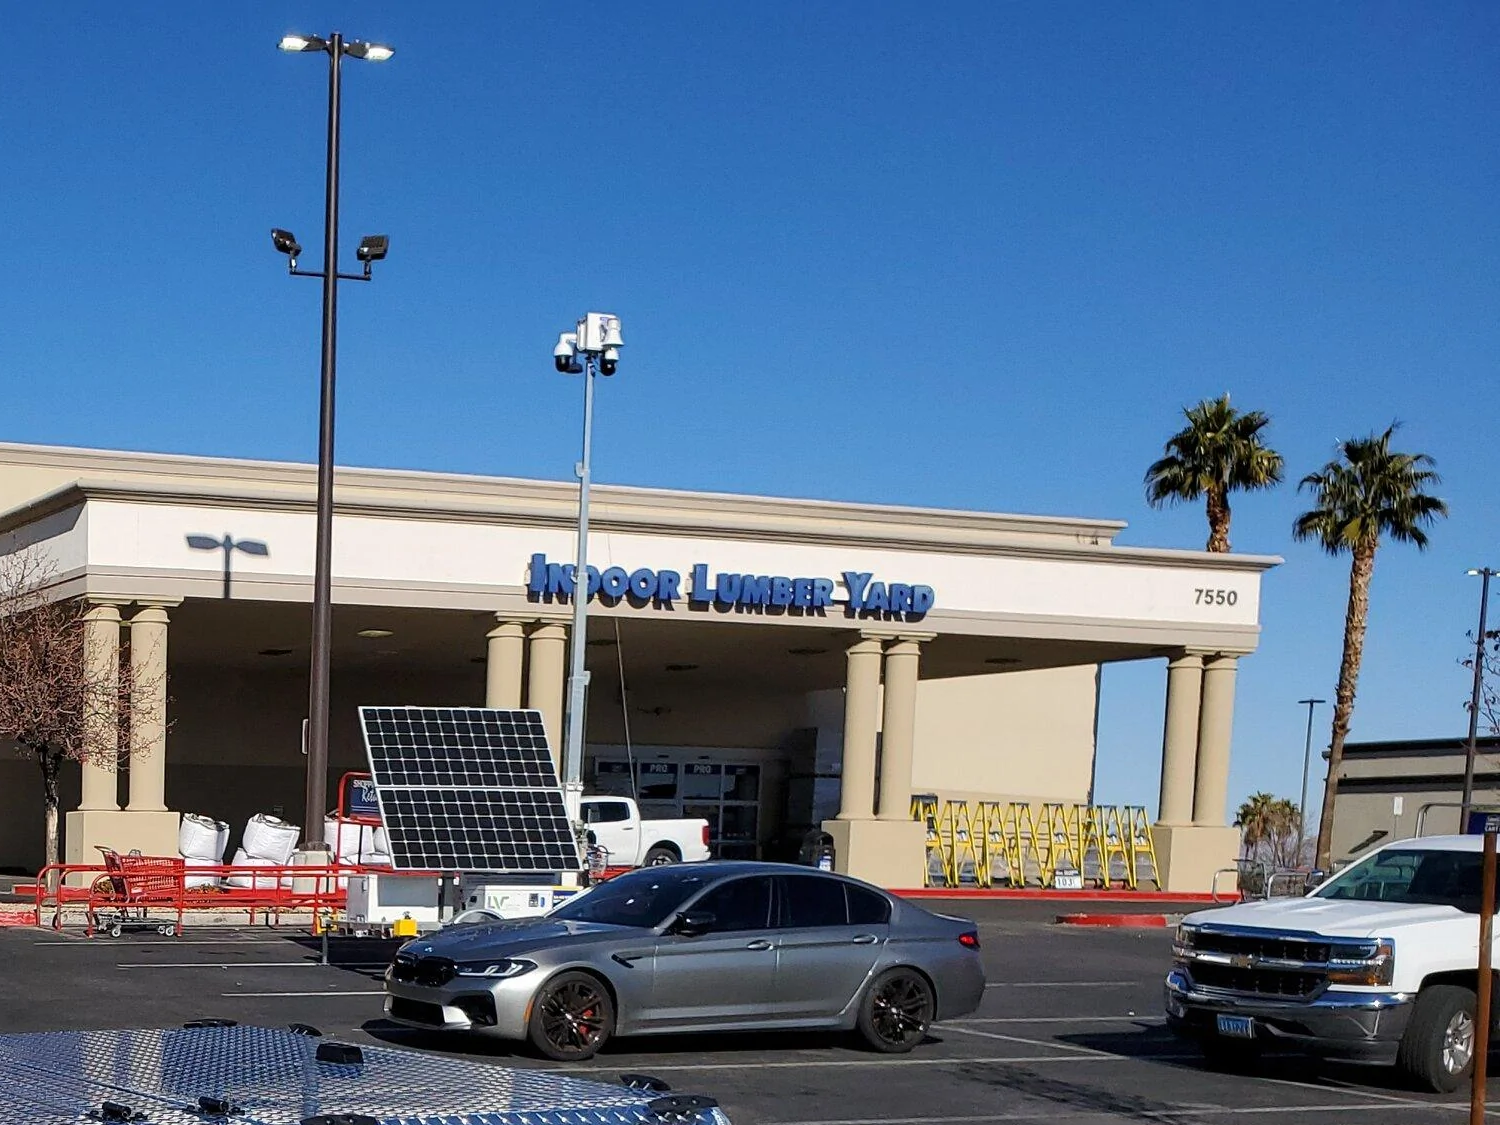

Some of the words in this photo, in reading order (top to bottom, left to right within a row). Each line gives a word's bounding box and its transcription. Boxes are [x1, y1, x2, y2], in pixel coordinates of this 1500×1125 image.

[529, 553, 682, 600] INDOOR
[691, 563, 835, 607] LUMBER
[841, 572, 935, 613] YARD
[1194, 588, 1238, 606] 7550
